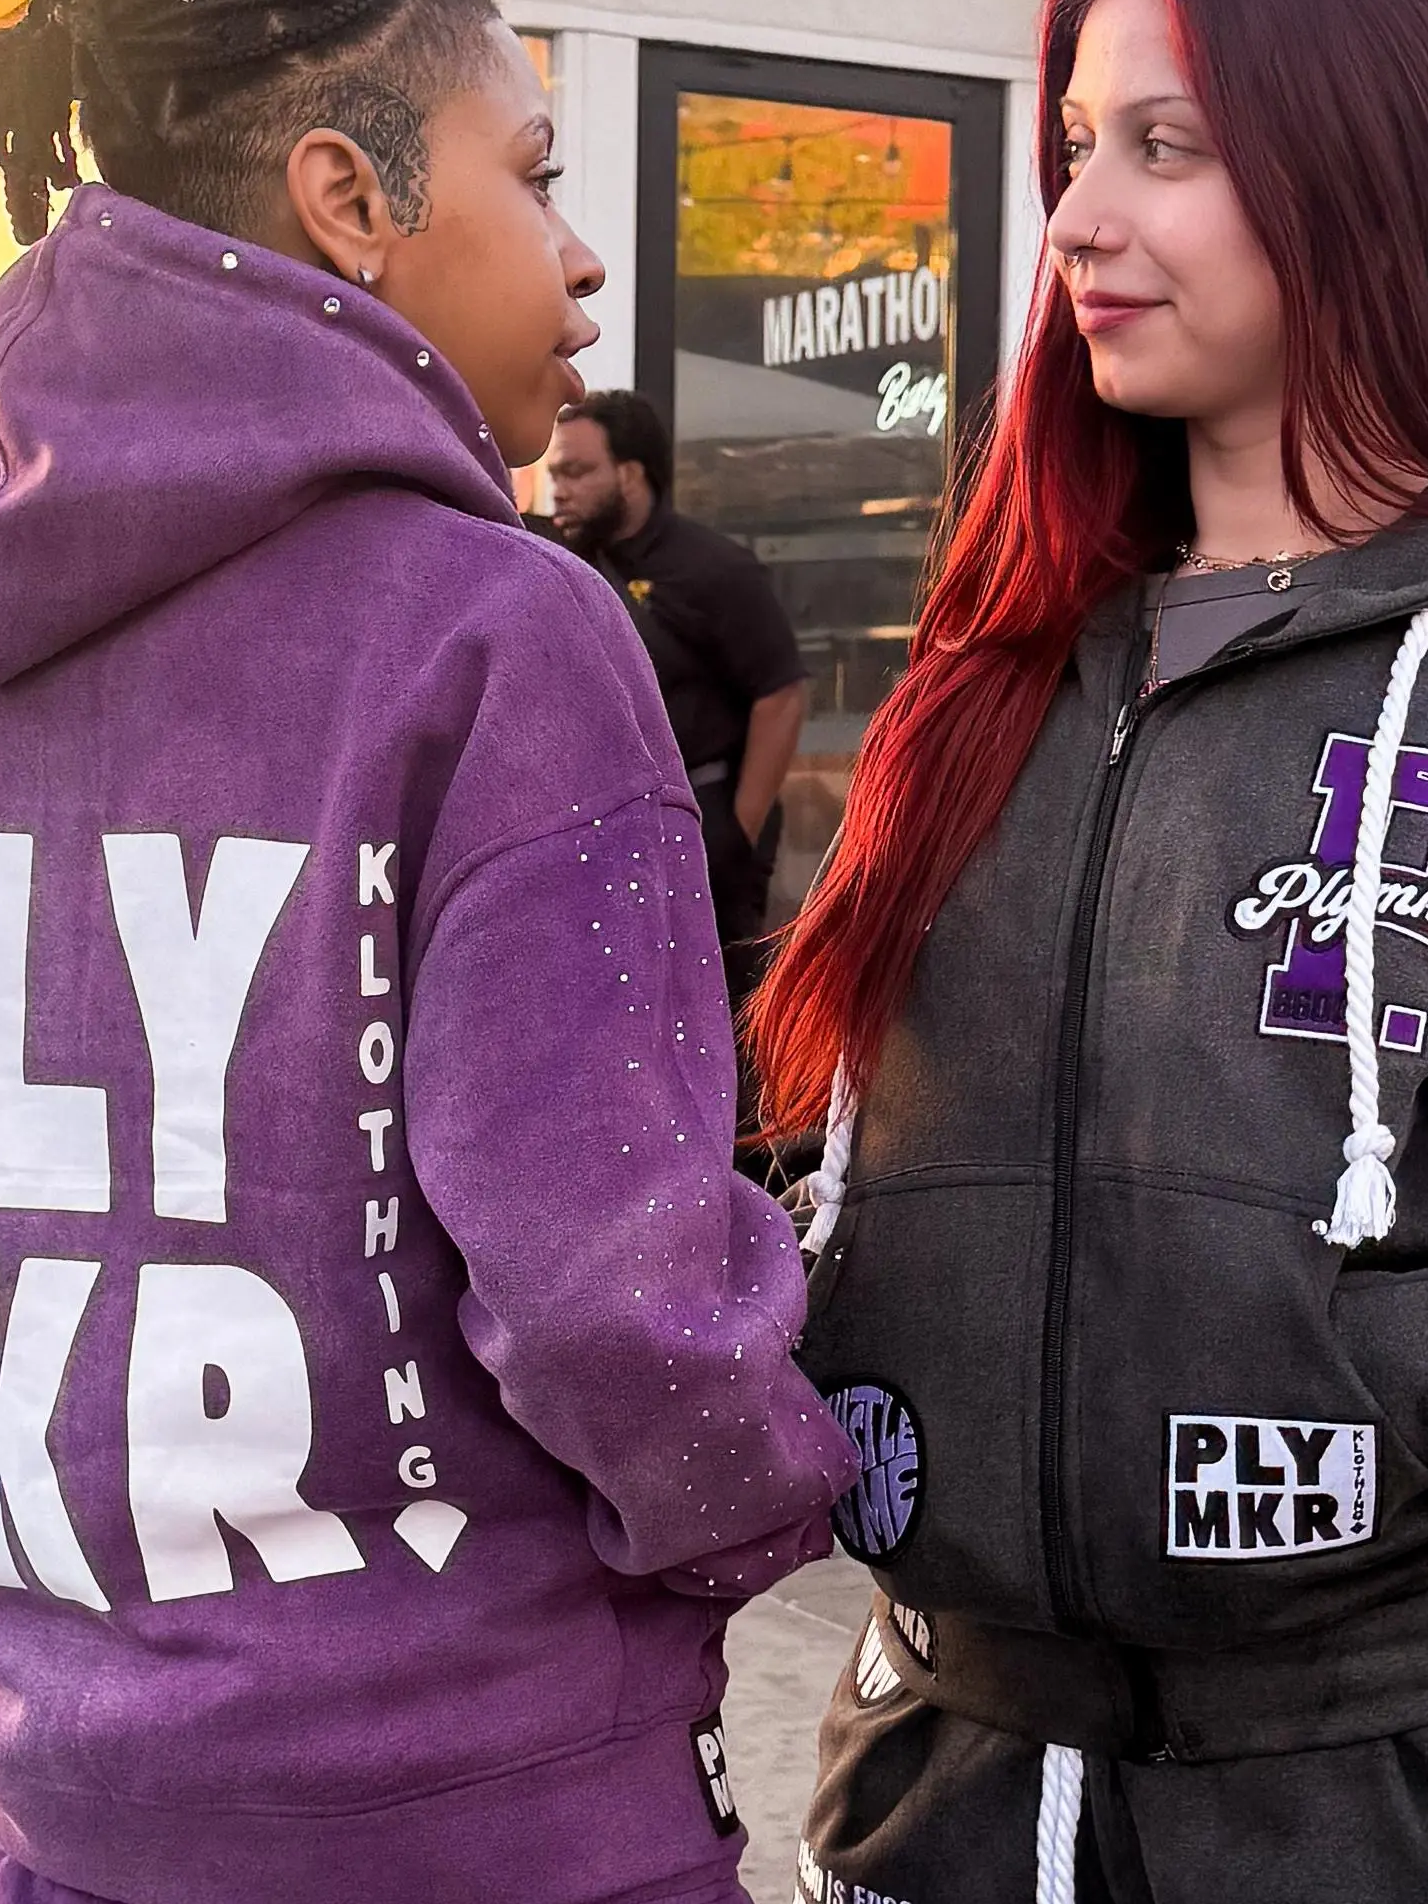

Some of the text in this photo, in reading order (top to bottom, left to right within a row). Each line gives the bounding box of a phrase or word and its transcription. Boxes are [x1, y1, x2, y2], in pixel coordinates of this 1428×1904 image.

[357, 841, 438, 1490] KLOTHING
[1174, 1423, 1338, 1487] PLY
[1174, 1489, 1344, 1549] MKR
